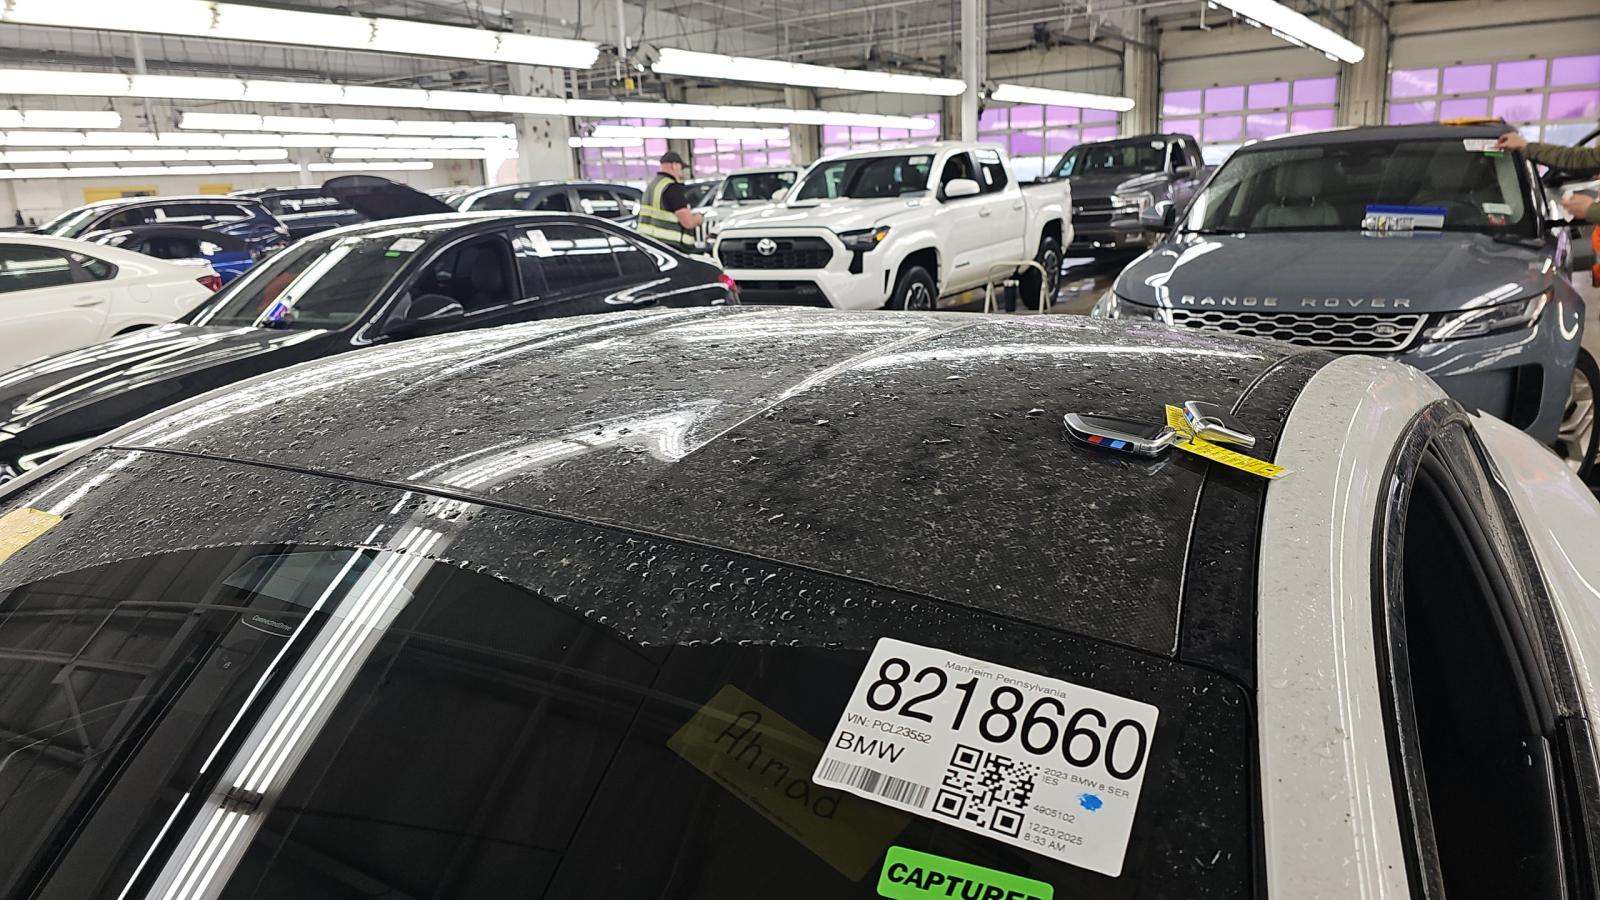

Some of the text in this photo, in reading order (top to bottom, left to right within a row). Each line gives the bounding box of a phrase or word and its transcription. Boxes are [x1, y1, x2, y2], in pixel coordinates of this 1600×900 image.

[1181, 295, 1411, 308] RANGE ROVER
[944, 660, 1067, 699] Manheim Pennsylvania
[847, 712, 932, 744] VIN: PCL23552
[866, 657, 1148, 781] 8218660
[835, 730, 906, 764] BMW
[714, 710, 842, 820] Ahmad
[1044, 767, 1068, 780] 2023
[1071, 774, 1097, 788] BMW
[1107, 786, 1130, 799] SER
[1033, 804, 1076, 824] 4905102
[1023, 832, 1066, 852] 8:33 AM
[1029, 822, 1084, 846] 12/23/2025
